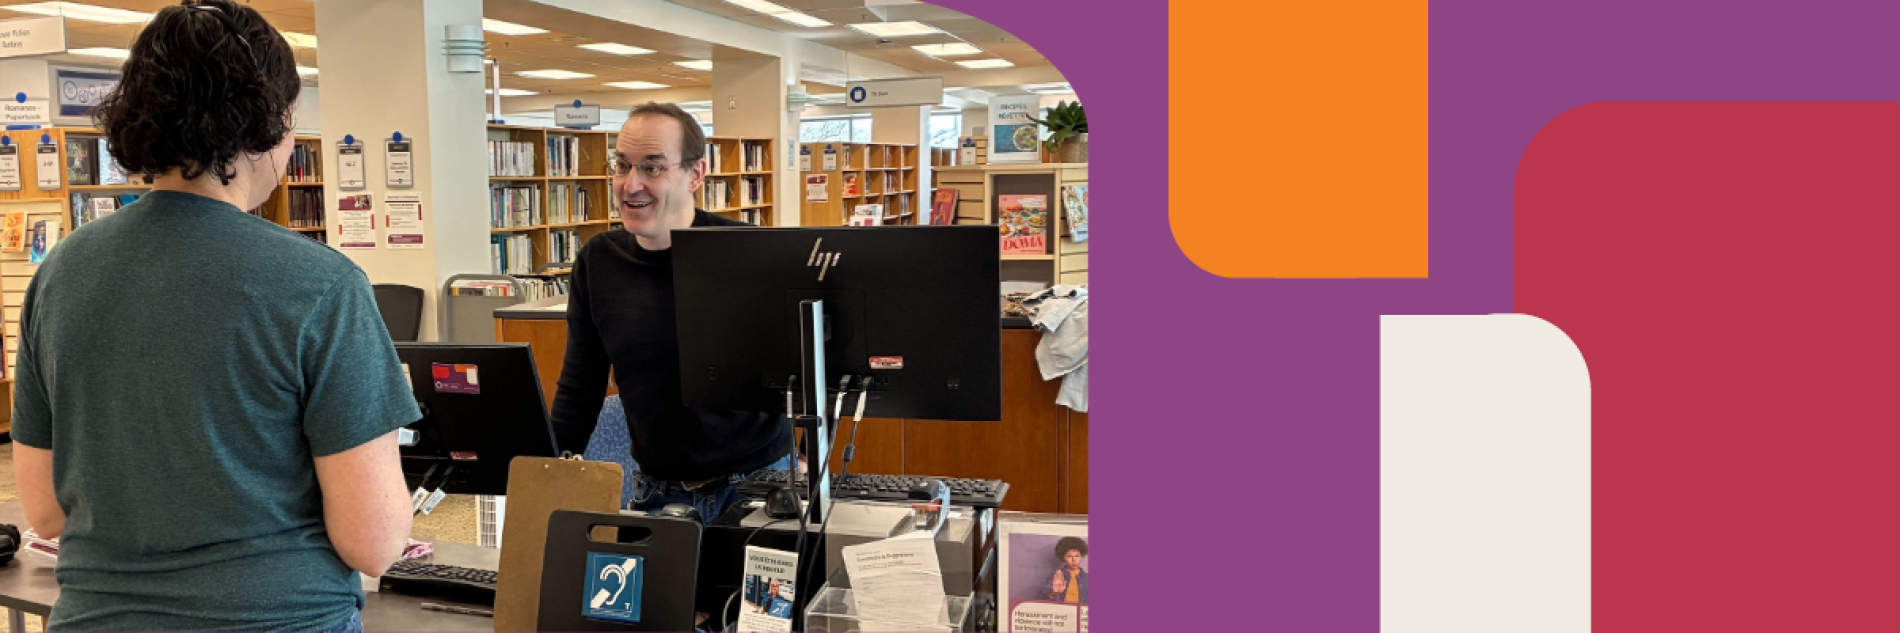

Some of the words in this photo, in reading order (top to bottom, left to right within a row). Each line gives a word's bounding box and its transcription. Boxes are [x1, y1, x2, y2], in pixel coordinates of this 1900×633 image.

[807, 237, 841, 281] hp
[1014, 610, 1054, 619] Harassment
[1054, 613, 1068, 621] and
[1014, 618, 1041, 626] violence
